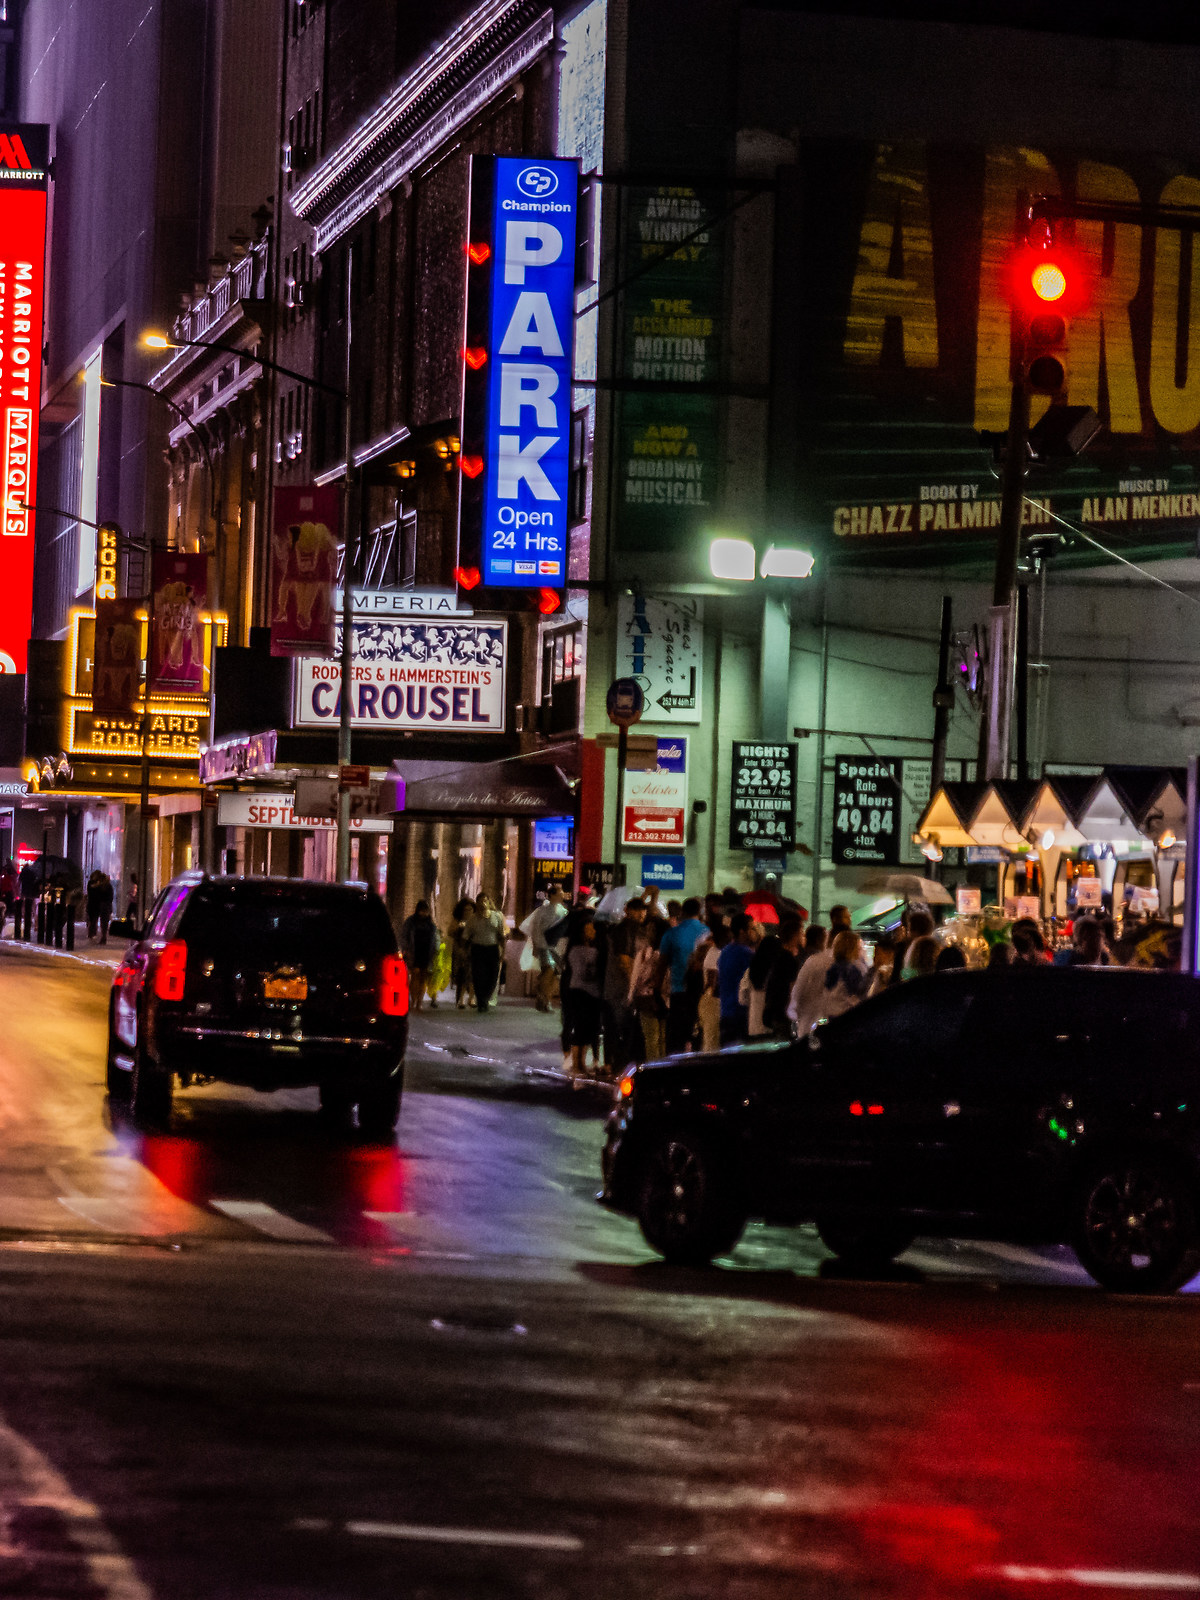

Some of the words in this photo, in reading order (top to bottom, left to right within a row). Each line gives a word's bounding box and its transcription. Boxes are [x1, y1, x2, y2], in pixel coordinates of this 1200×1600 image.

[502, 199, 572, 214] Champion
[11, 263, 32, 401] MARRIOTT
[634, 336, 705, 361] MOTION
[498, 220, 565, 501] PARK
[920, 485, 956, 500] BOOK
[960, 484, 979, 499] BY
[1119, 480, 1149, 494] MUSIC
[1153, 479, 1169, 492] BY
[498, 506, 554, 529] Open
[833, 504, 913, 536] CHAZZ
[919, 498, 1052, 532] PALMINERI
[1082, 498, 1128, 523] ALAN
[492, 531, 517, 549] 24
[525, 532, 562, 551] Hrs.
[343, 595, 452, 610] MPERIA
[312, 665, 372, 681] RODERS
[376, 667, 385, 681] &
[390, 668, 491, 685] HAMMERSTEIN'S
[740, 746, 790, 758] NIGHTS
[738, 769, 791, 787] 32.95
[840, 763, 895, 778] Special
[856, 779, 877, 791] Rate
[735, 800, 792, 811] MAXIMUM
[839, 793, 854, 806] 24
[859, 794, 893, 807] Hours
[737, 821, 786, 835] 49.84
[837, 809, 893, 834] 49.84
[854, 835, 875, 845] +tax
[653, 864, 673, 872] NO
